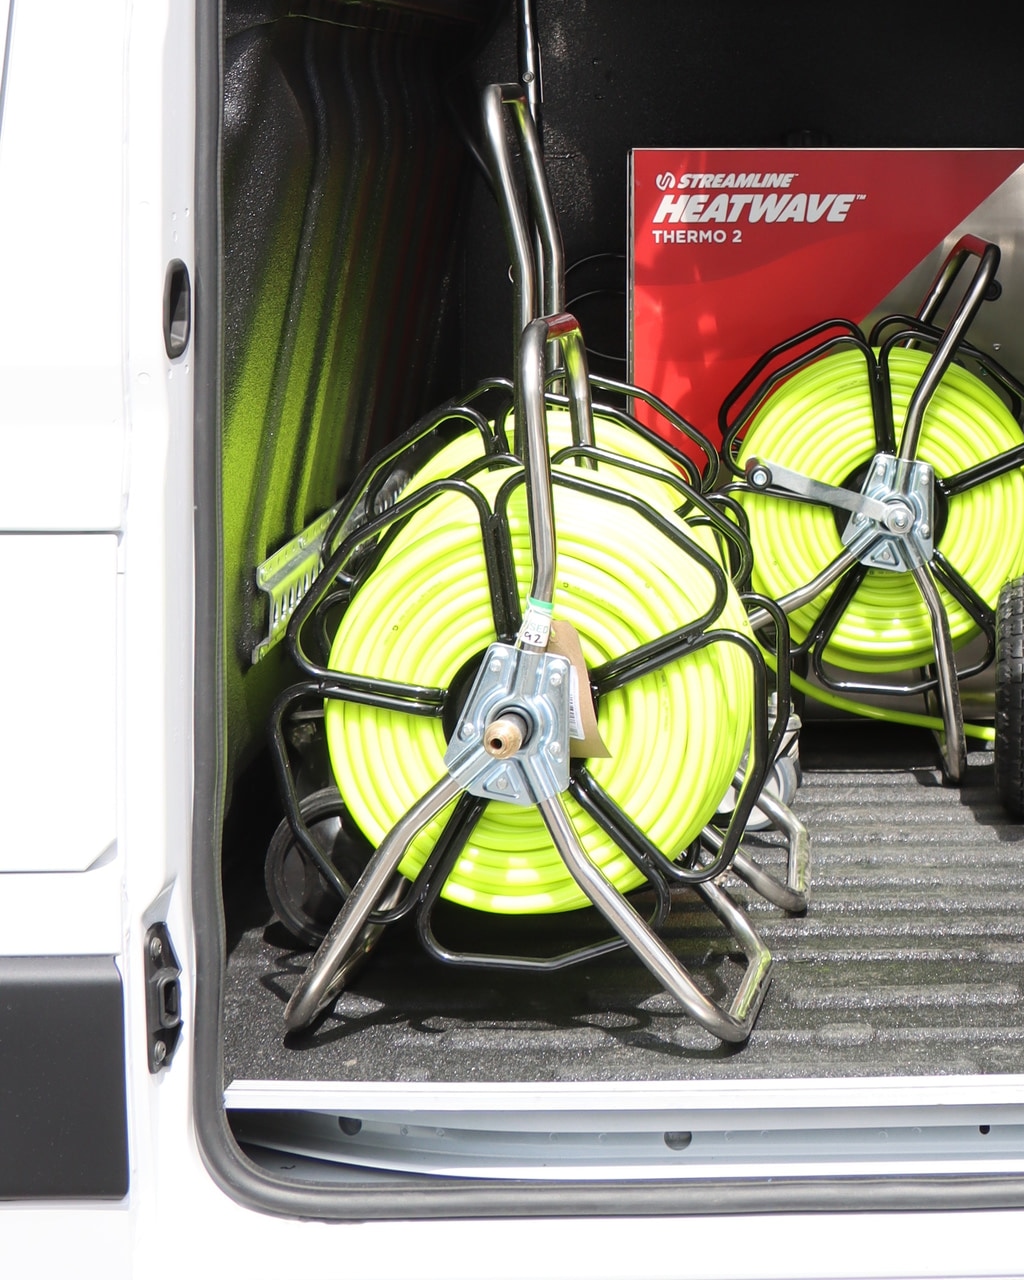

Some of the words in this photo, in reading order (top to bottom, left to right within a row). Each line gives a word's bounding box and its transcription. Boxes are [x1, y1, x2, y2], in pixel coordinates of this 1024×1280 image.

[677, 173, 793, 189] STREAMLINE
[652, 229, 727, 244] THERMO
[732, 229, 742, 243] 2
